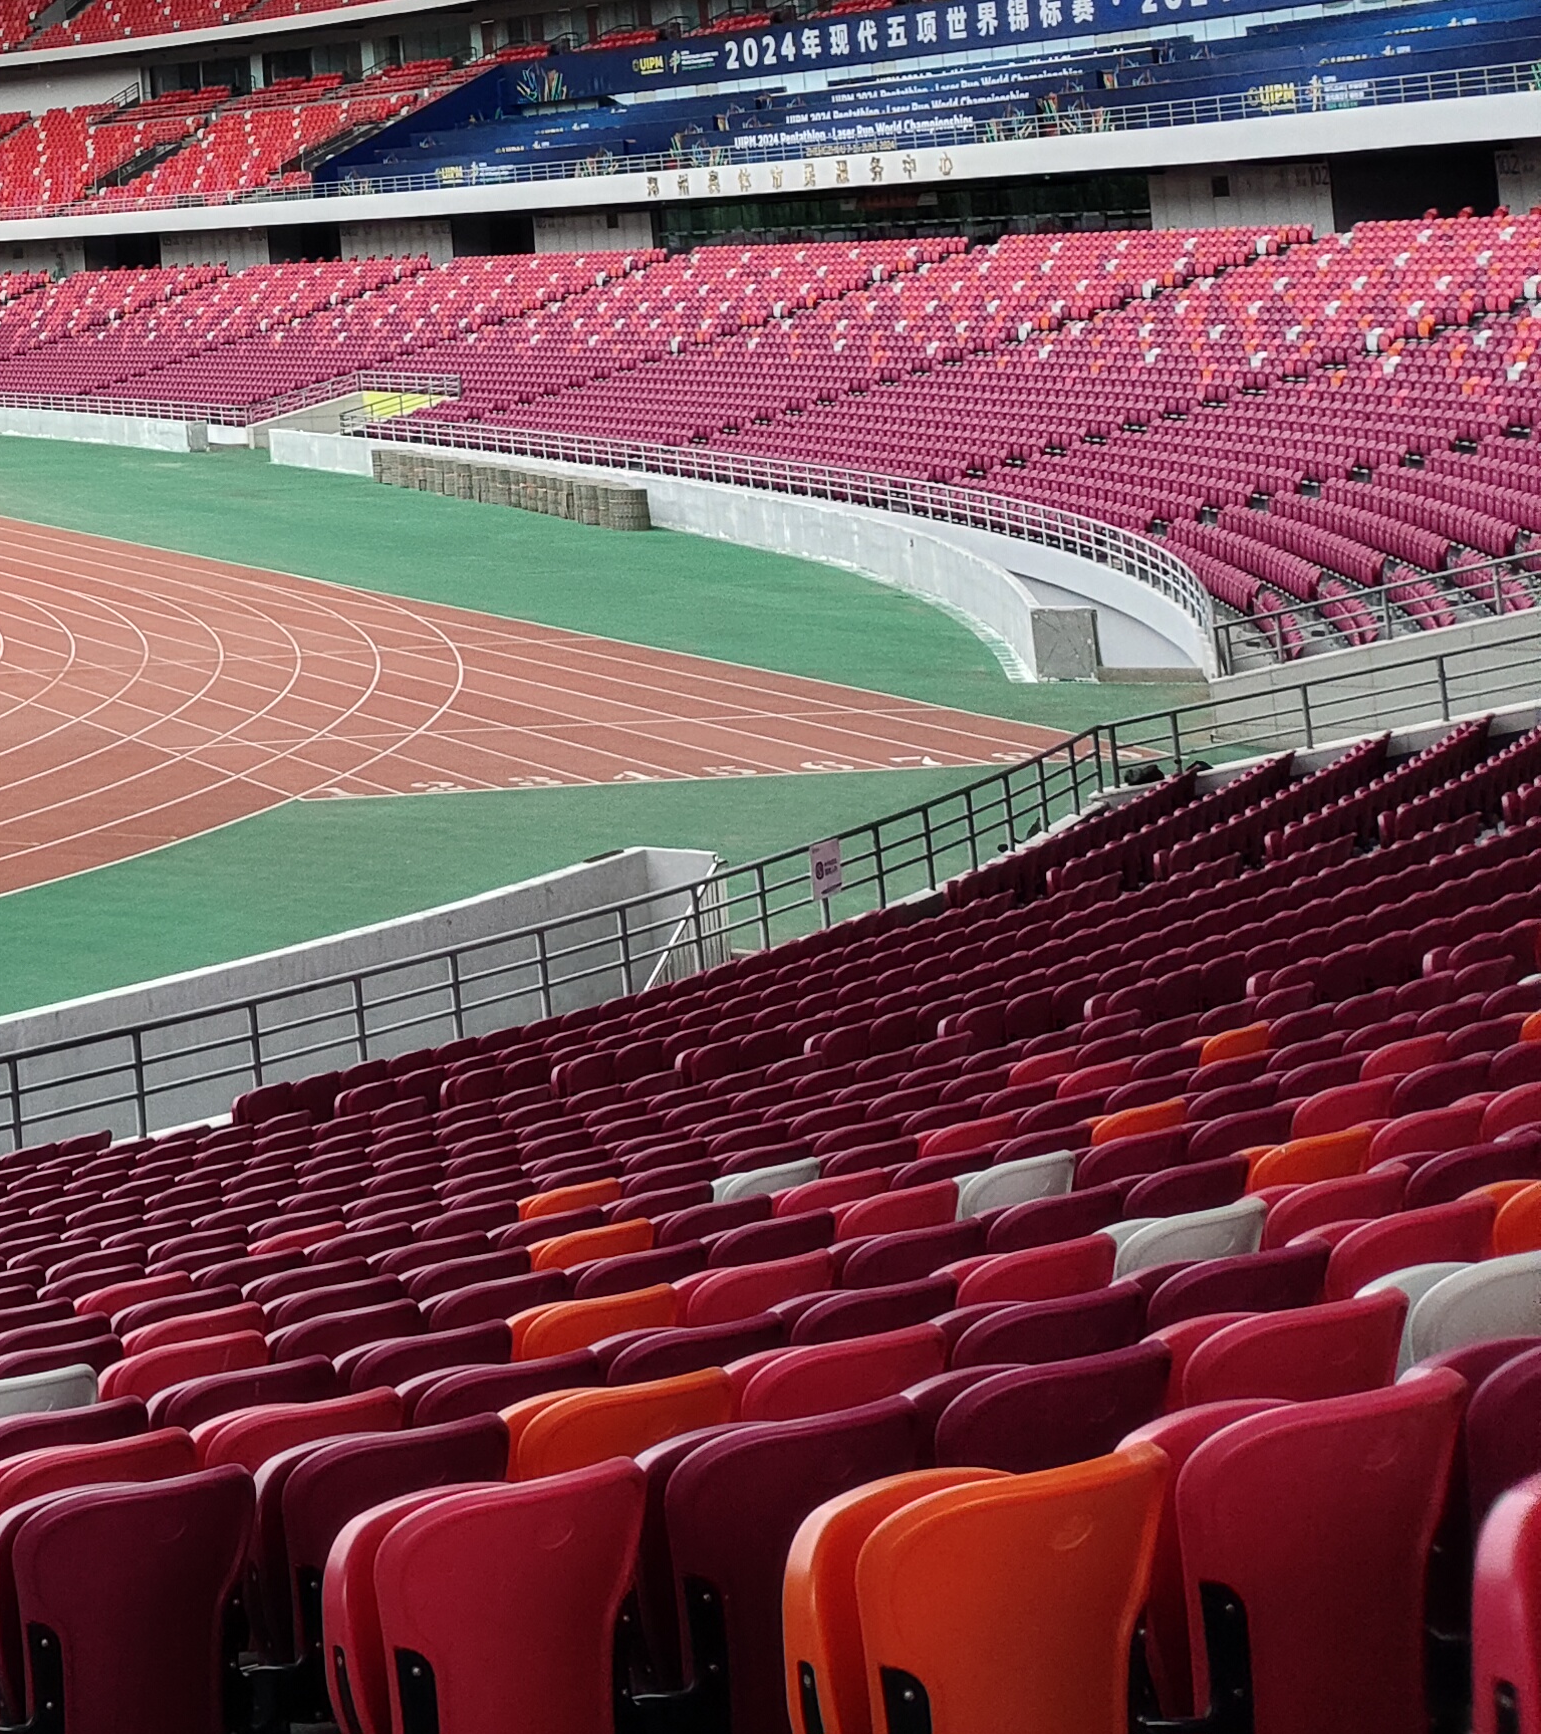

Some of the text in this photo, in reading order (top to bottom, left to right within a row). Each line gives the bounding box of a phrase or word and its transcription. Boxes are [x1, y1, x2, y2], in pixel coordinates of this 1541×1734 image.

[780, 128, 826, 146] Pentathlon
[832, 126, 856, 141] Laser
[856, 124, 875, 138] Run
[875, 121, 903, 136] World
